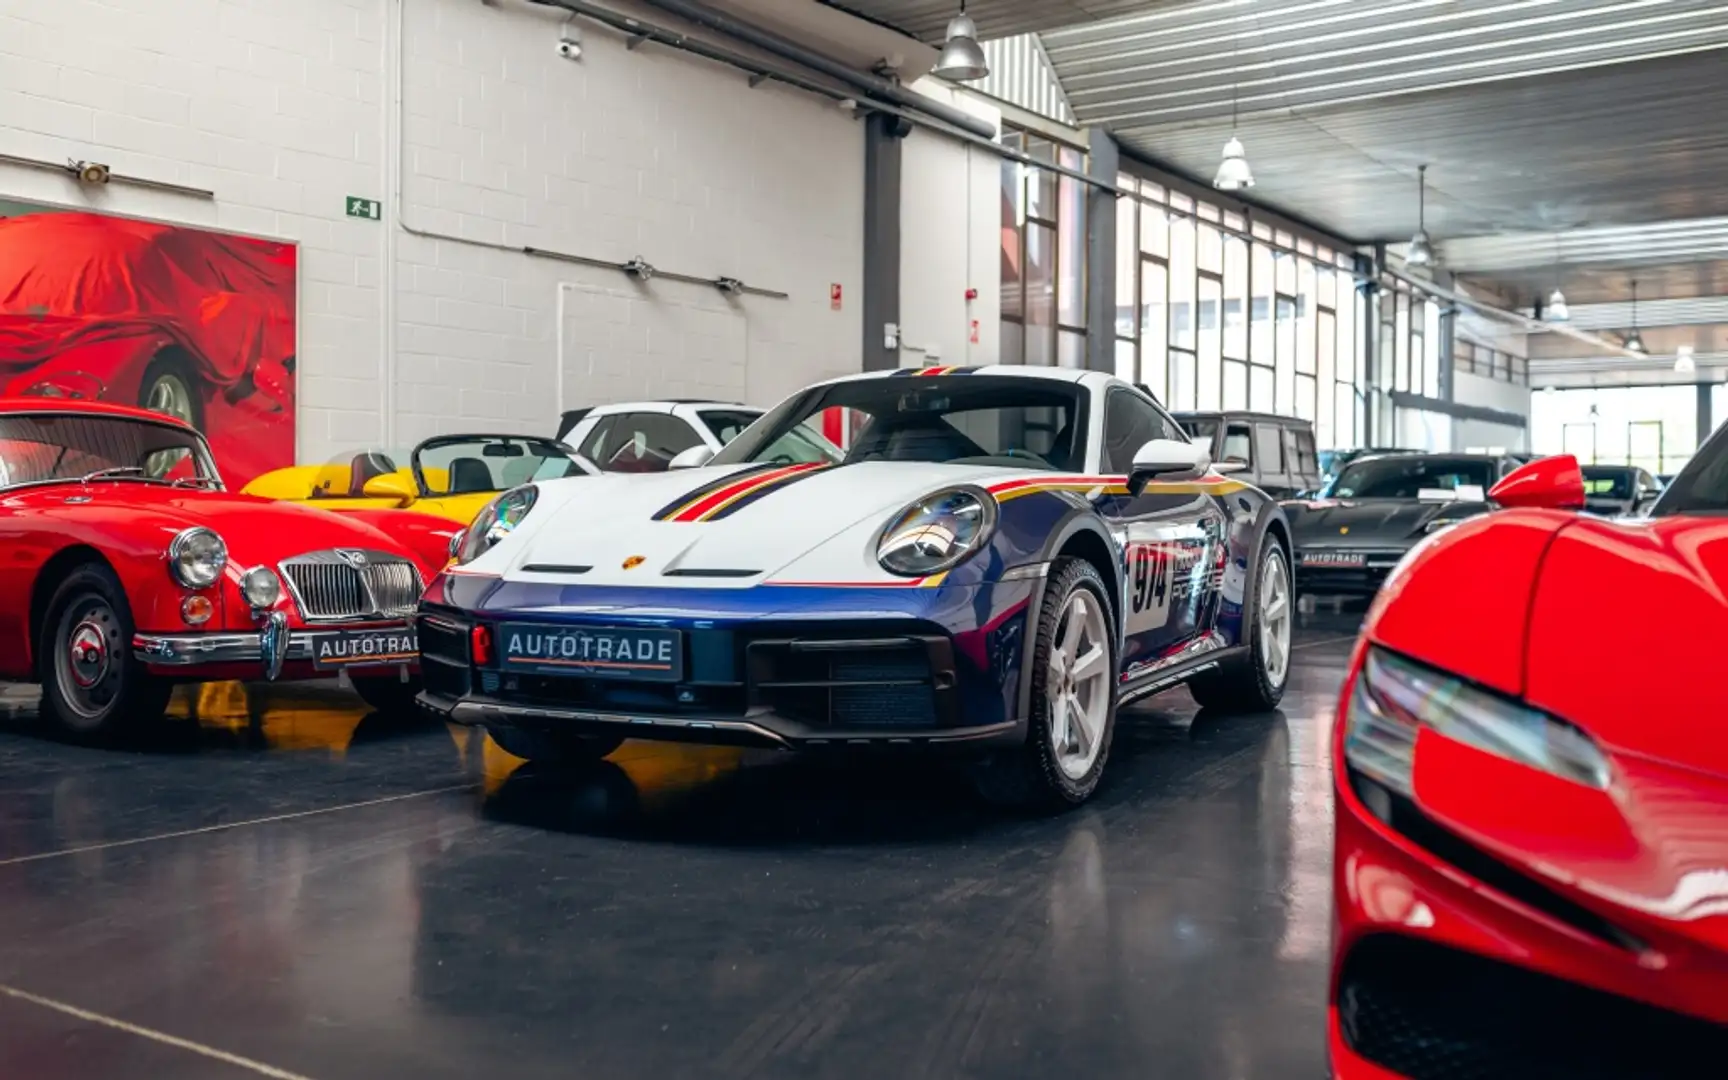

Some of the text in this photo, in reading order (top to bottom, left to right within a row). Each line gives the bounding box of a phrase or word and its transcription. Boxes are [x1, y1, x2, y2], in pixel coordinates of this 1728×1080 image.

[1303, 553, 1364, 563] AUTOTRADE
[1132, 546, 1167, 614] 974
[508, 633, 672, 661] AUTOTRADE
